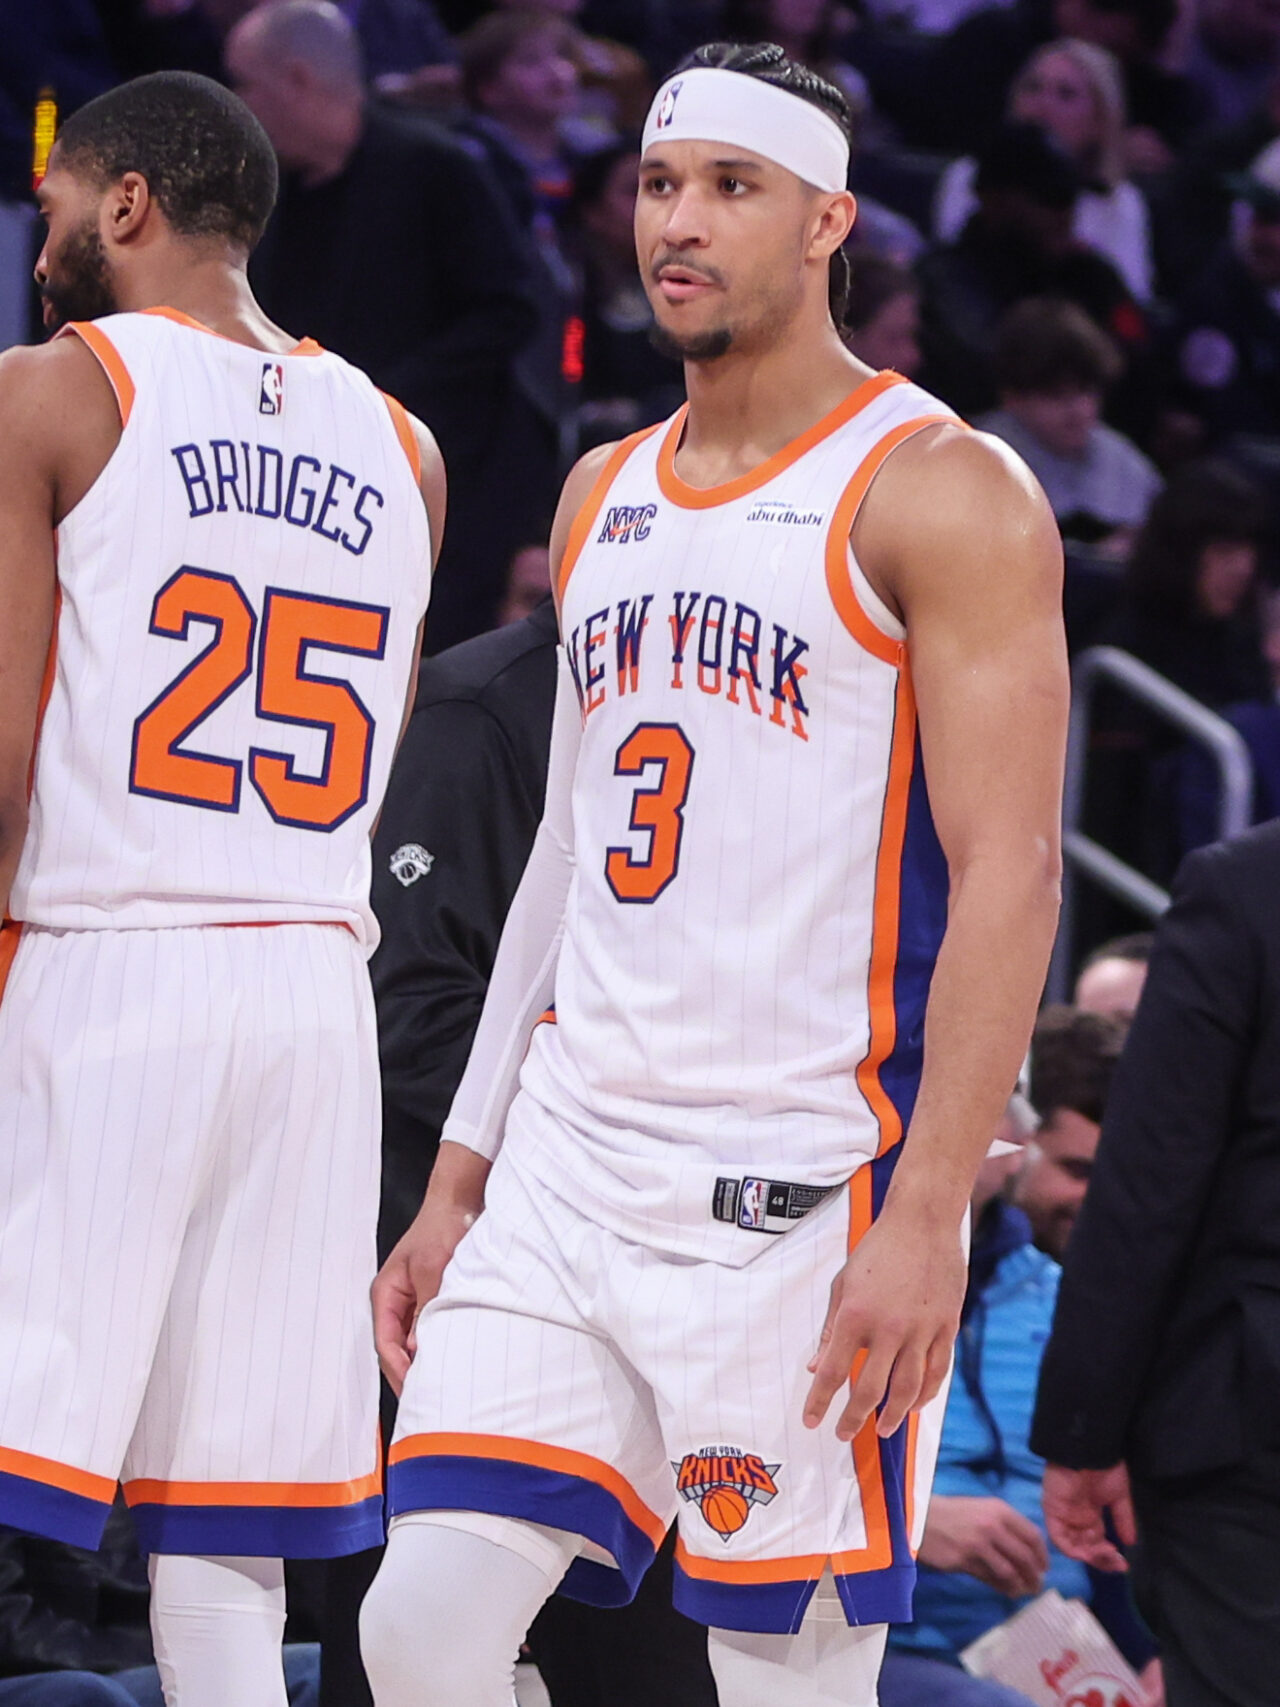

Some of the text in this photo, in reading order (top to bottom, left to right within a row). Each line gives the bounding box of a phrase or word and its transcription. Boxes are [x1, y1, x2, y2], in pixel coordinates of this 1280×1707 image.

[171, 439, 384, 556] BRIDGES
[597, 503, 658, 543] NYC
[747, 508, 824, 526] abu dhabi
[129, 564, 391, 834] 25
[668, 592, 809, 742] YORK
[604, 722, 696, 904] 3
[677, 1453, 779, 1496] KNICKS
[699, 1446, 743, 1459] NEW YORK
